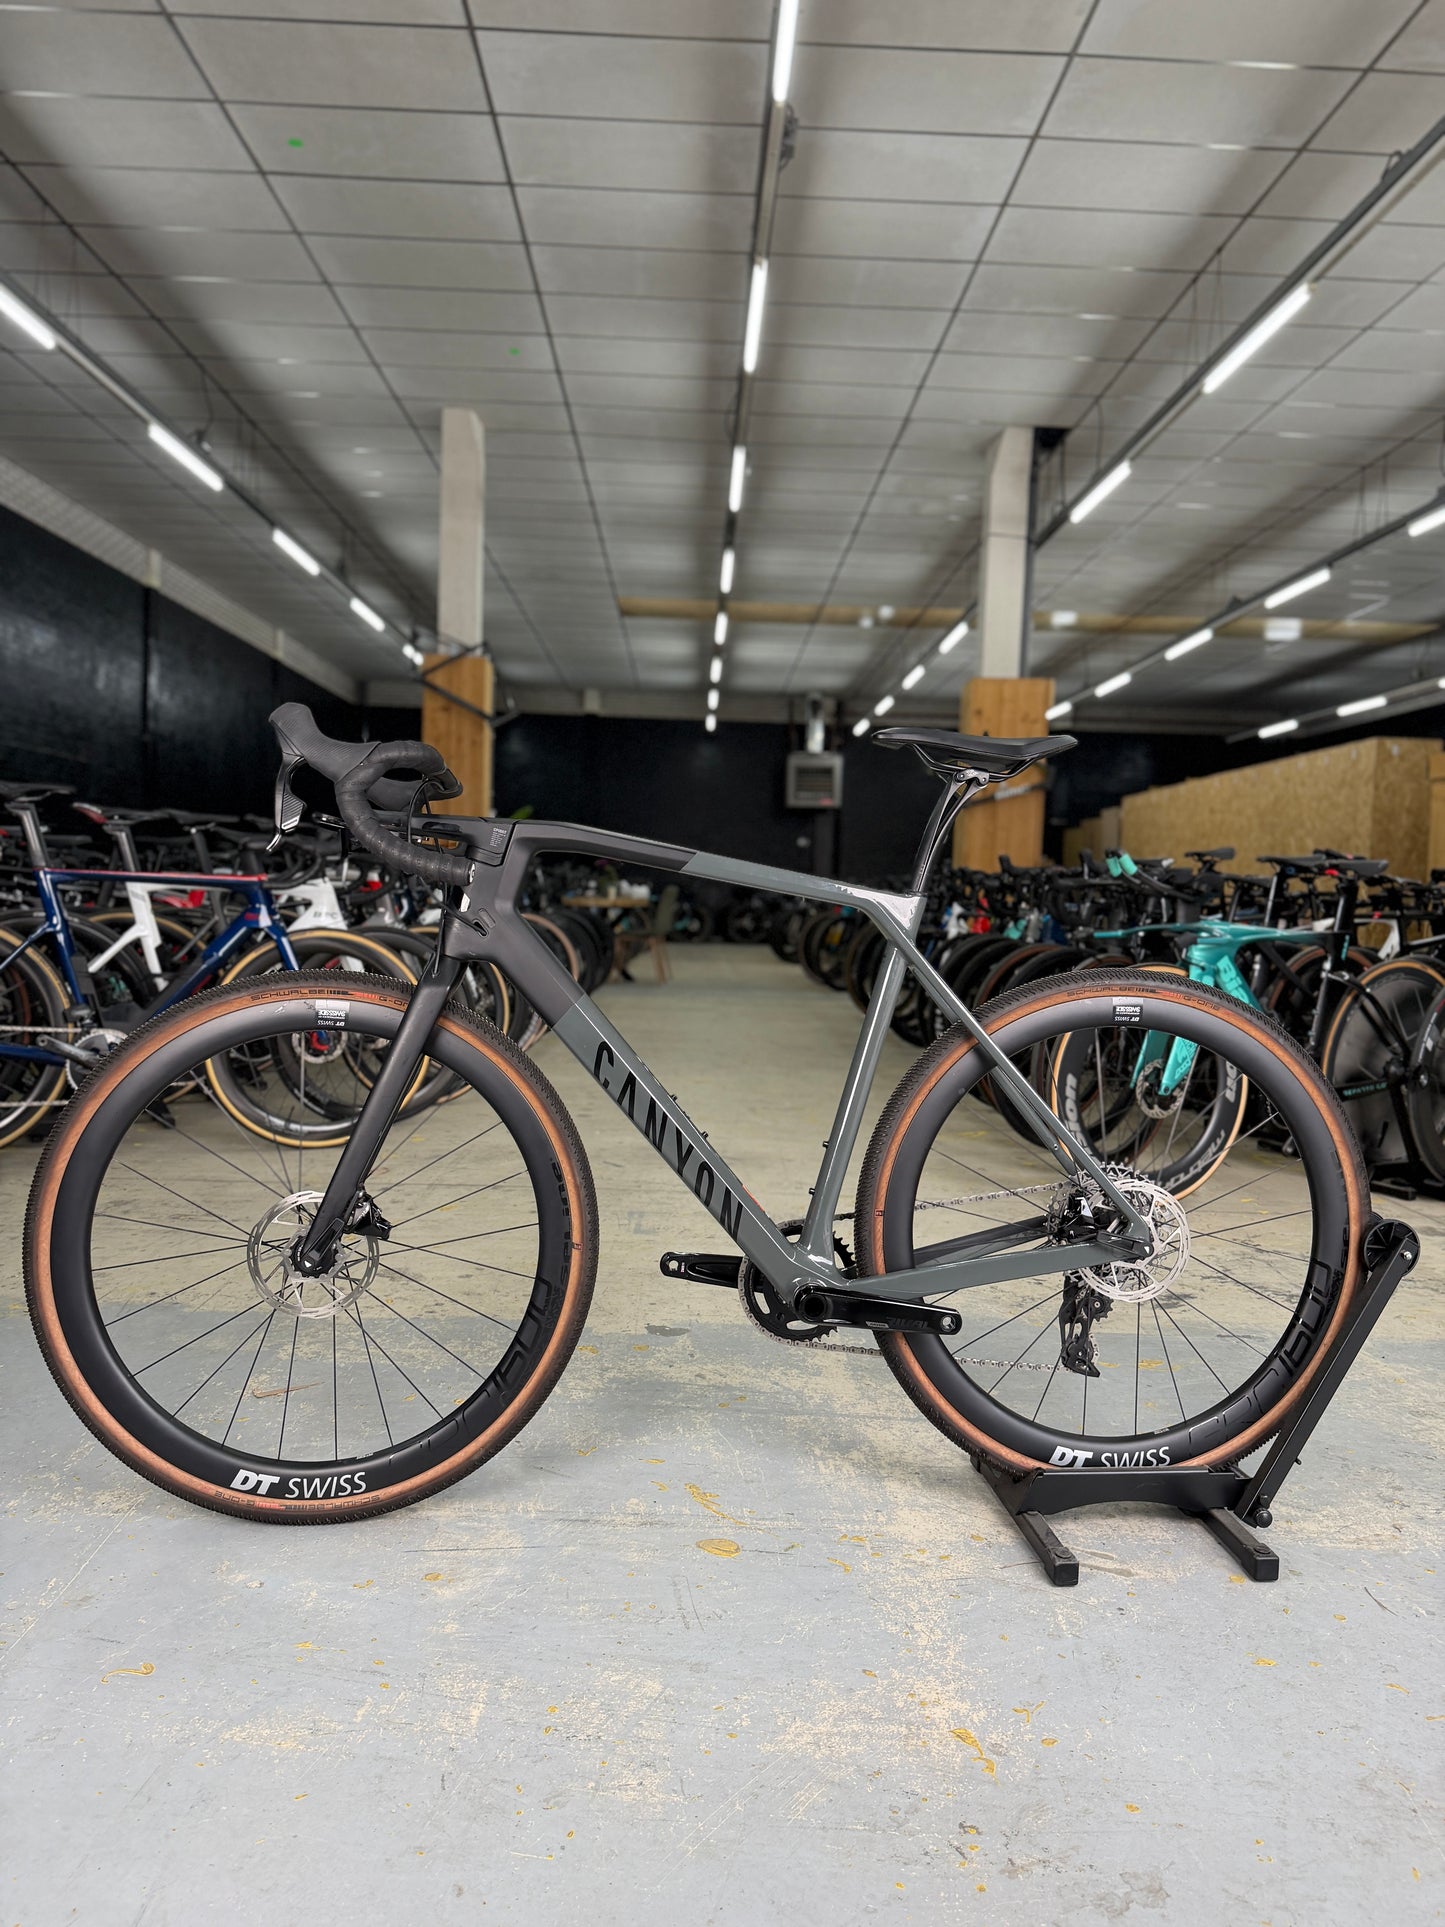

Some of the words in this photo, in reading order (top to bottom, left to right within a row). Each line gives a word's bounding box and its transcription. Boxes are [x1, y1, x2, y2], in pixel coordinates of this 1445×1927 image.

[250, 989, 327, 1001] SCHWALBE
[1067, 986, 1135, 997] SCHWALBE
[593, 1040, 744, 1243] CANYON
[1276, 1259, 1332, 1377] 1600
[1050, 1445, 1094, 1468] DT
[1100, 1446, 1171, 1468] SWISS
[230, 1468, 281, 1495] DT
[285, 1471, 367, 1499] SWISS
